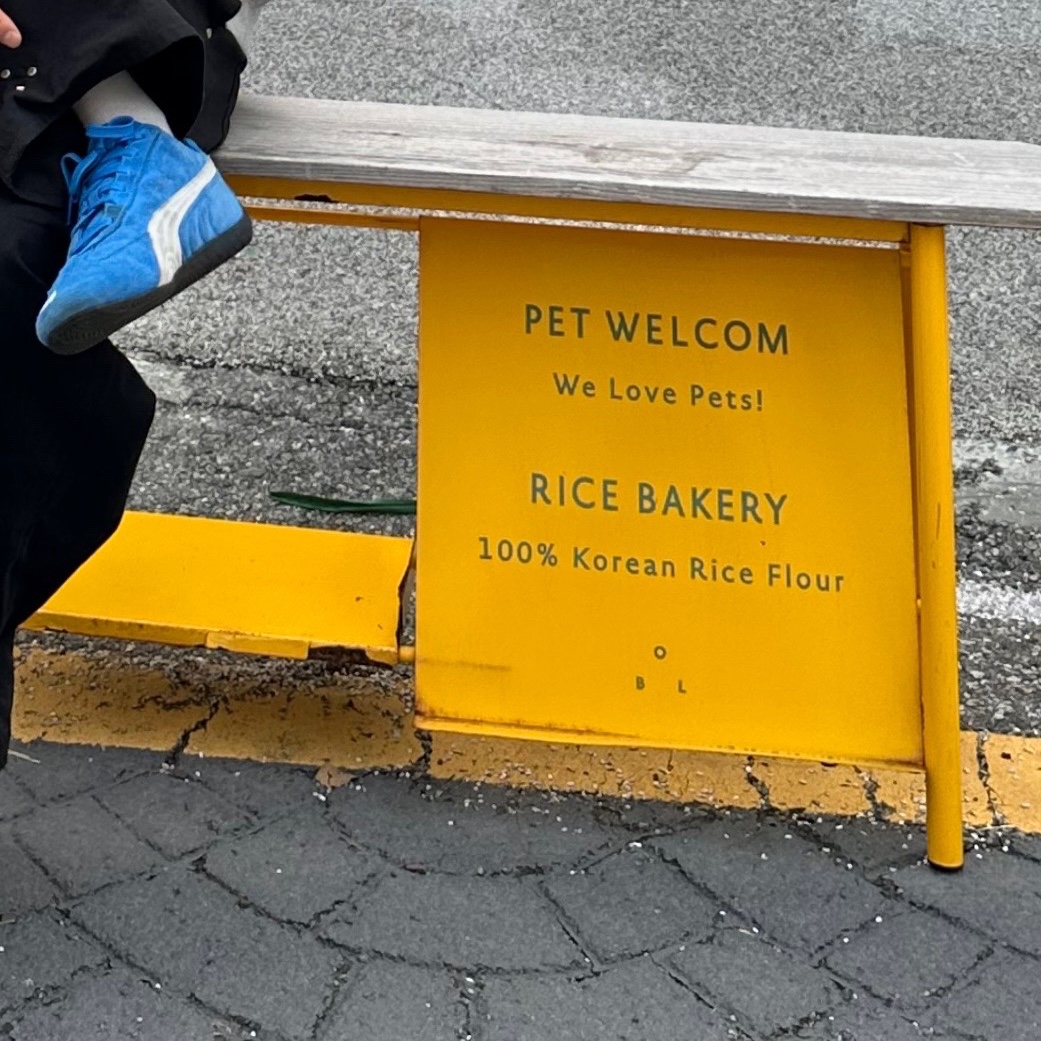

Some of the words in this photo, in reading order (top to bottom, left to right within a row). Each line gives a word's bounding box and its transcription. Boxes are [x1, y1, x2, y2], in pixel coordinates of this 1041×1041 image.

[525, 303, 590, 338] PET
[605, 310, 788, 355] WELCOM
[553, 372, 596, 398] We
[609, 377, 677, 405] Love
[690, 384, 764, 411] Pets!
[531, 472, 619, 512] RICE
[638, 482, 787, 525] BAKERY
[479, 536, 558, 567] 100%
[573, 546, 676, 578] Korean
[690, 556, 753, 585] Rice
[768, 563, 844, 592] Flour
